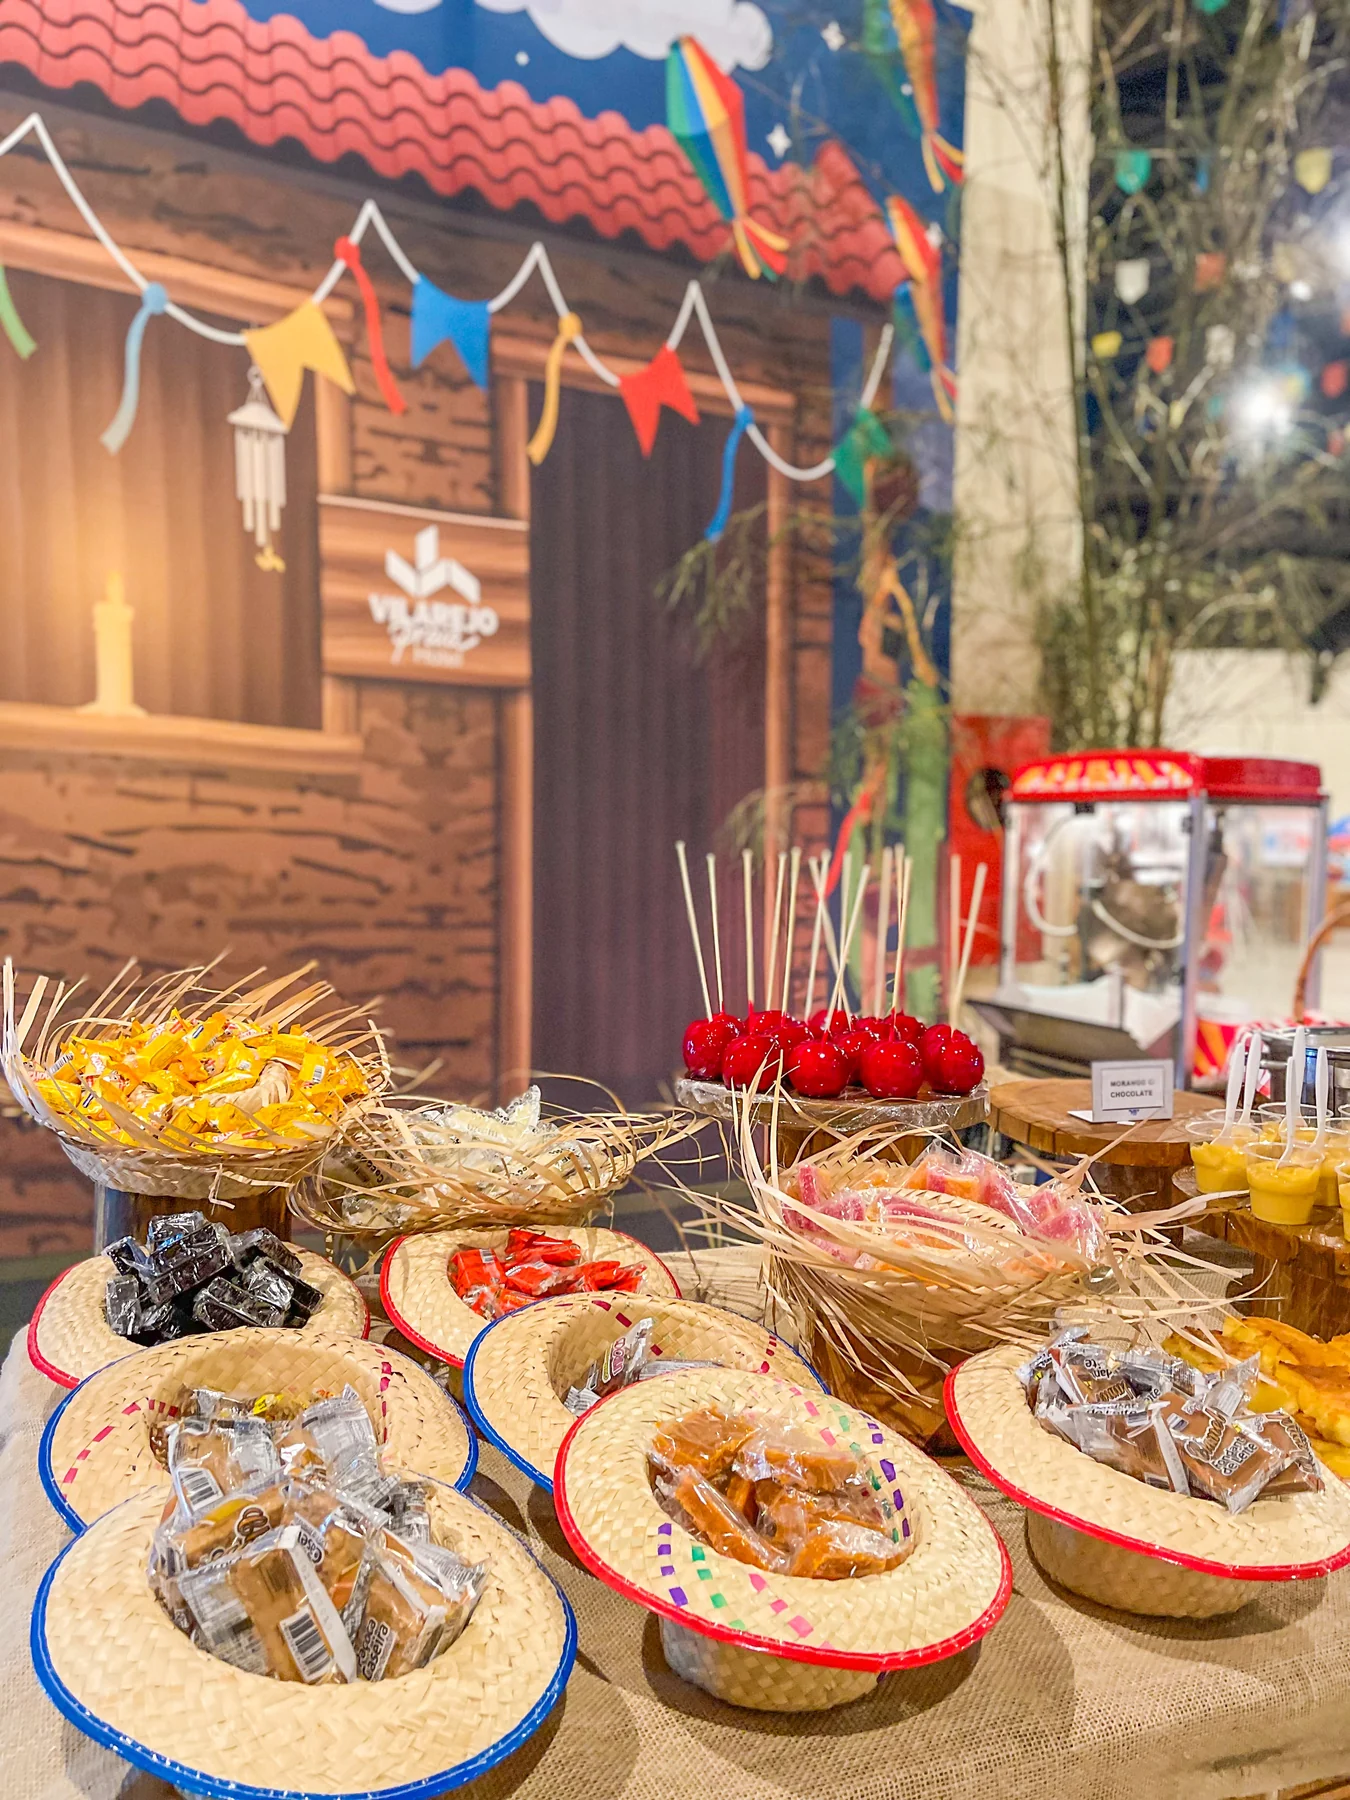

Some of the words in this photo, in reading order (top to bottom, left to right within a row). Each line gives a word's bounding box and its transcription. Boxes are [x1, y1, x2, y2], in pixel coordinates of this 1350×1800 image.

[368, 593, 499, 636] VILAREJO
[1110, 1089, 1153, 1098] CHOCOLATE
[1212, 1438, 1246, 1467] Fondant
[1223, 1461, 1238, 1475] de
[1236, 1443, 1257, 1464] Leite
[362, 1623, 389, 1681] Caseira
